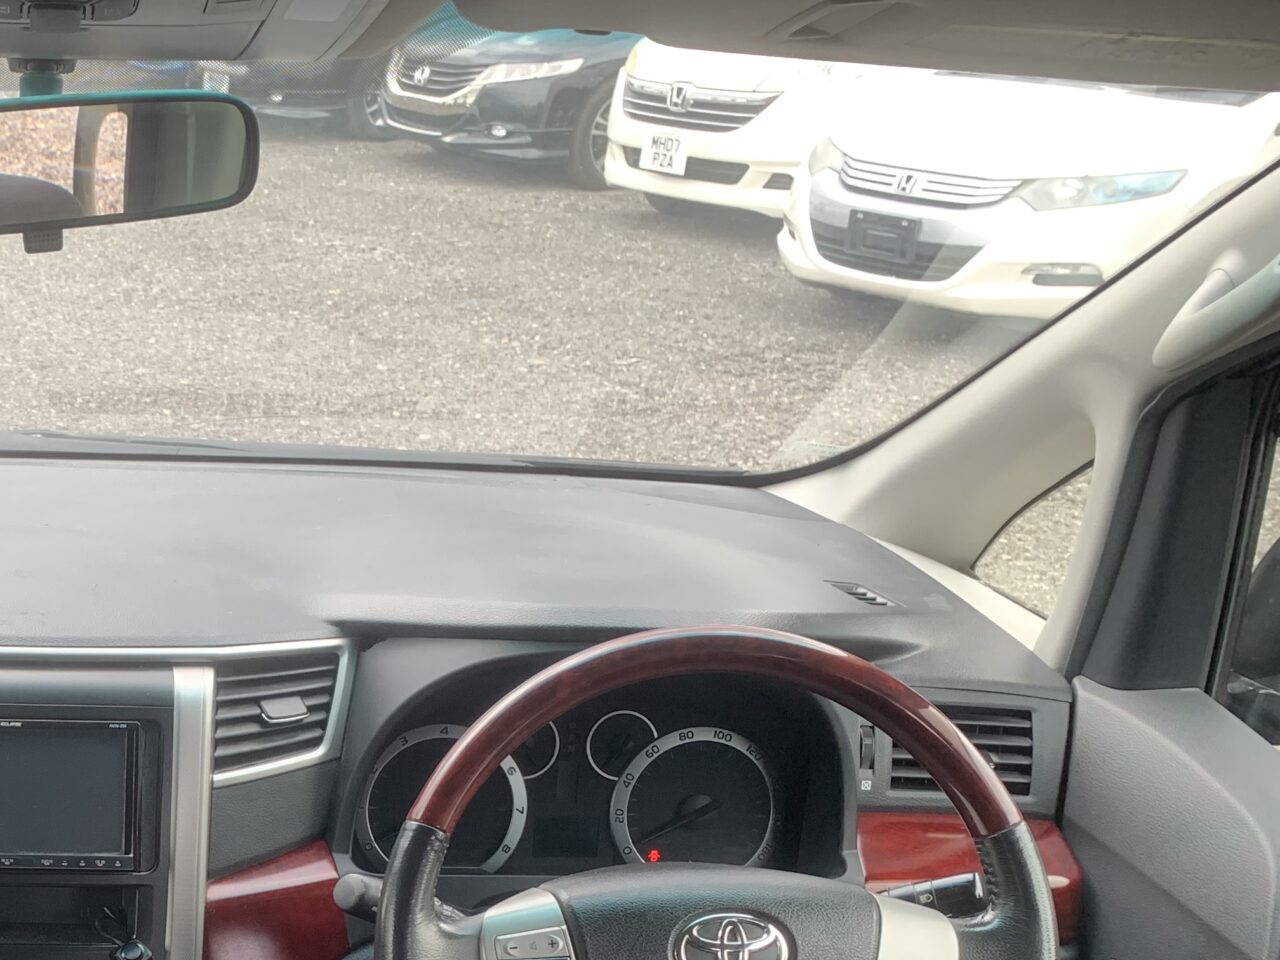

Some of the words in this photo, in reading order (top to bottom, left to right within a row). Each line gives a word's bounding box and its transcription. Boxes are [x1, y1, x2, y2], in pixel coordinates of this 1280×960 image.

[651, 135, 681, 153] MH07
[651, 152, 674, 168] PZA
[440, 726, 449, 736] 4
[678, 729, 694, 741] 80
[713, 729, 733, 743] 100
[399, 736, 409, 746] 3
[645, 744, 660, 759] 60
[745, 744, 762, 762] 120
[506, 766, 517, 776] 6
[622, 772, 635, 788] 40
[516, 806, 525, 814] 7
[614, 808, 625, 823] 20
[502, 844, 511, 854] 8
[622, 846, 632, 856] 0
